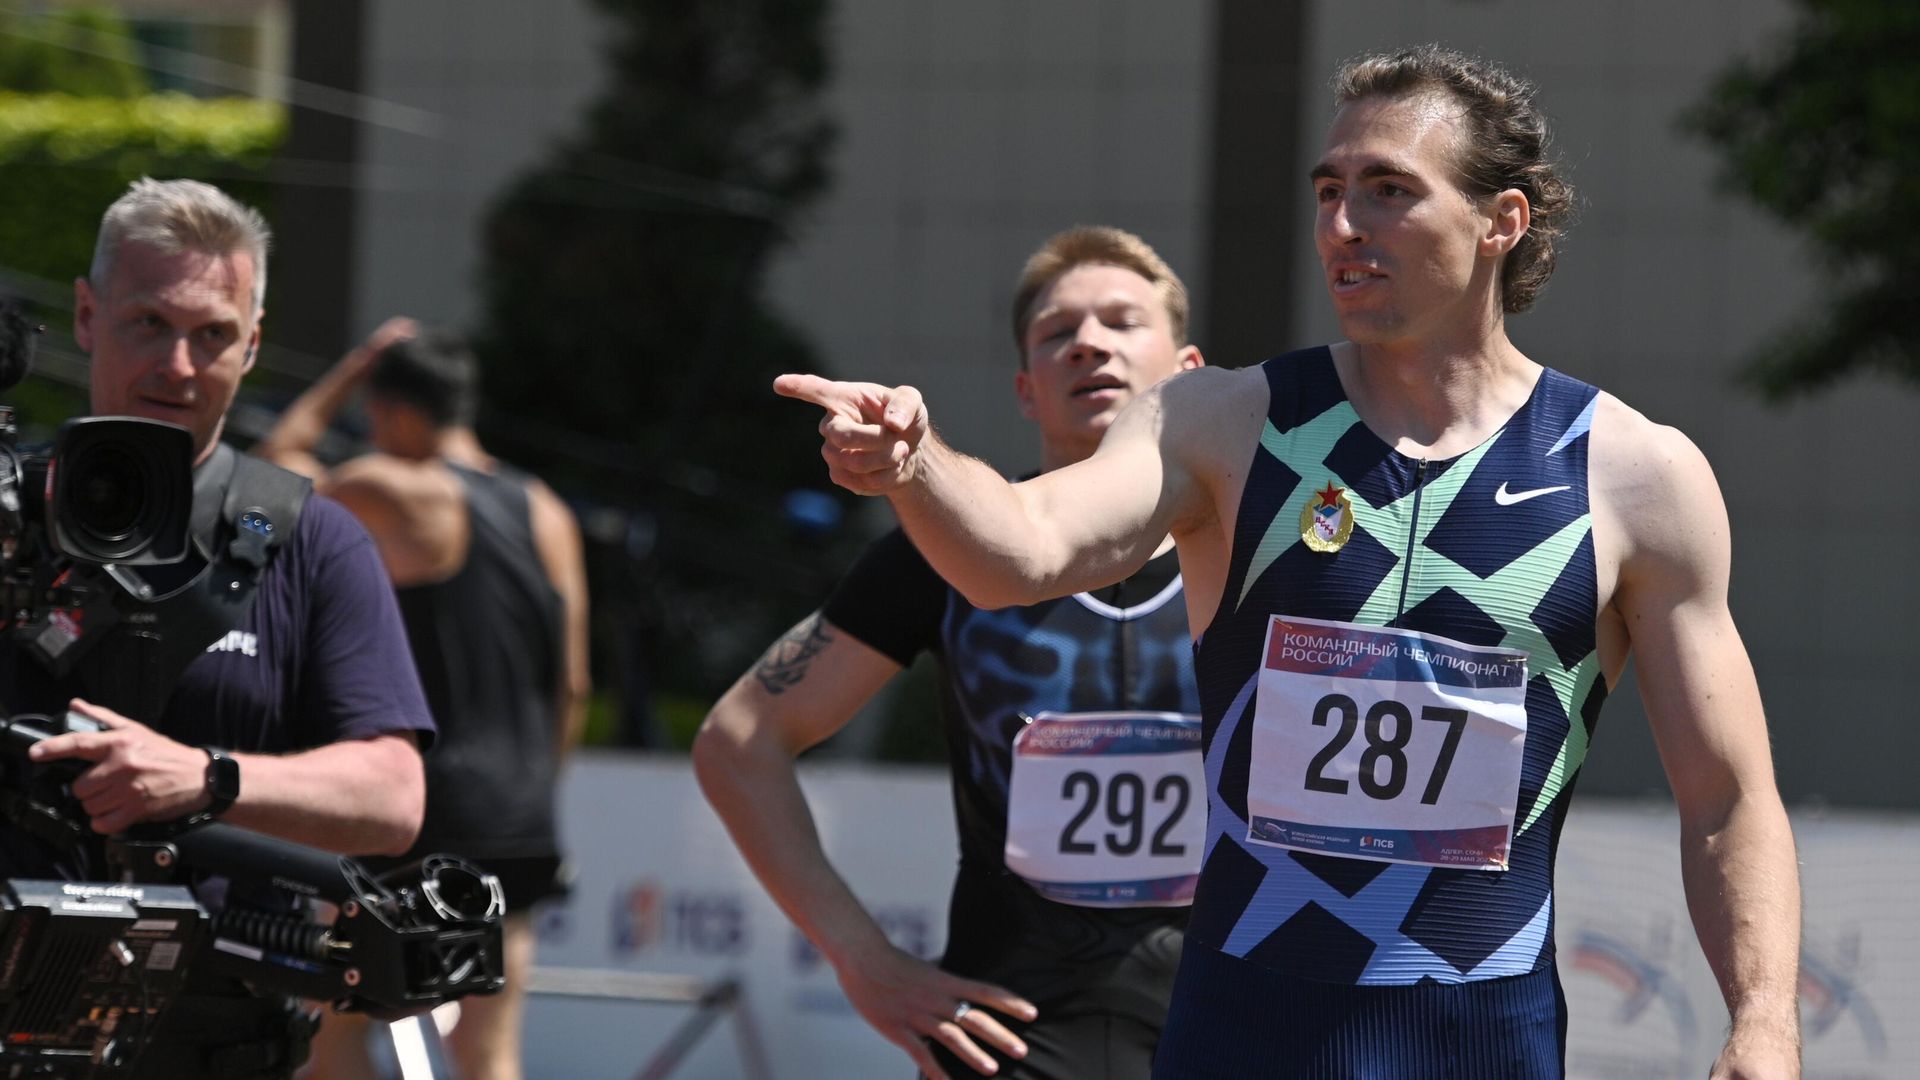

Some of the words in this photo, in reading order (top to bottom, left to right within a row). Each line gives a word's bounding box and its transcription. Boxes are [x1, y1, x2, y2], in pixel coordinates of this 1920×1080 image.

[1282, 647, 1353, 667] РОССИИ
[1284, 632, 1399, 658] КОМАНДНЫЙ
[1403, 647, 1511, 677] ЧЕМПИОНАТ
[1304, 693, 1469, 806] 287
[1059, 770, 1191, 857] 292
[1373, 838, 1394, 849] ПСБ
